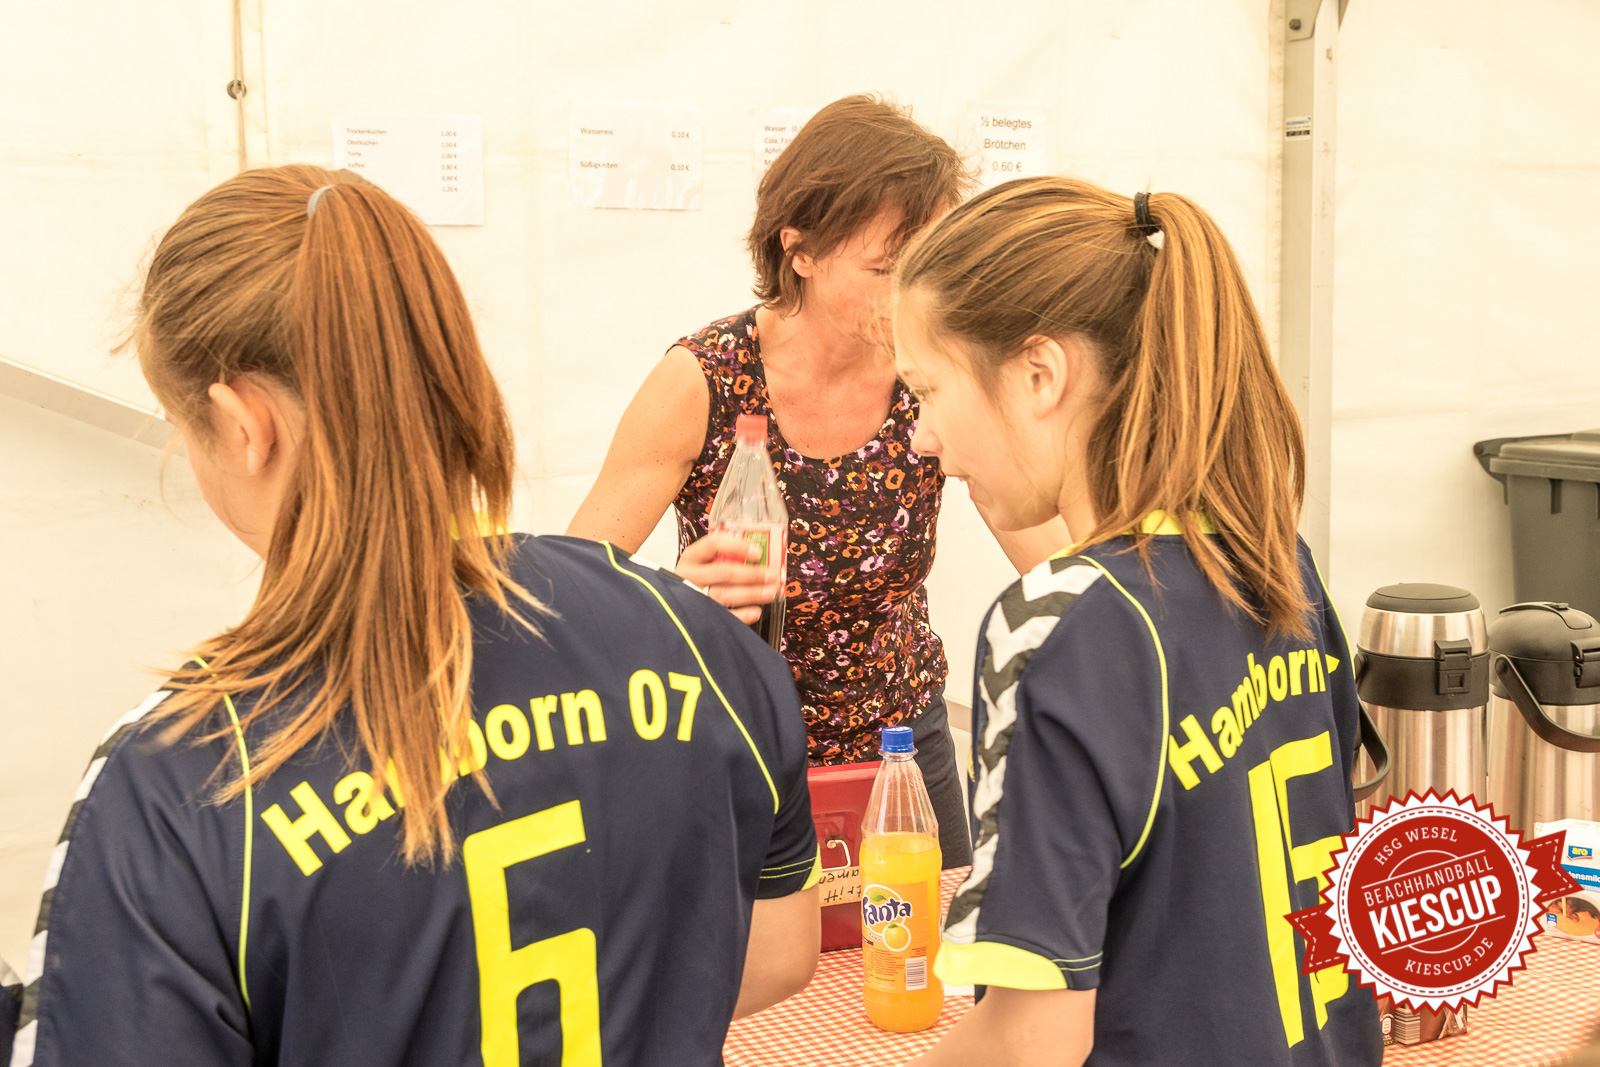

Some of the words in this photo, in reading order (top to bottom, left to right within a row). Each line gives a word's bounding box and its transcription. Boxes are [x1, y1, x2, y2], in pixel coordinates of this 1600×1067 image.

[992, 116, 1032, 131] belegtes
[579, 127, 614, 136] Wassereis
[671, 131, 685, 139] 0,10
[983, 137, 1026, 151] Brötchen
[579, 160, 618, 169] Süßigkeiten
[670, 163, 684, 172] 0,10
[1015, 161, 1023, 173] €
[628, 669, 703, 742] 07
[1168, 648, 1327, 791] Hamborn
[1571, 847, 1589, 856] aro
[463, 799, 604, 1067] 6
